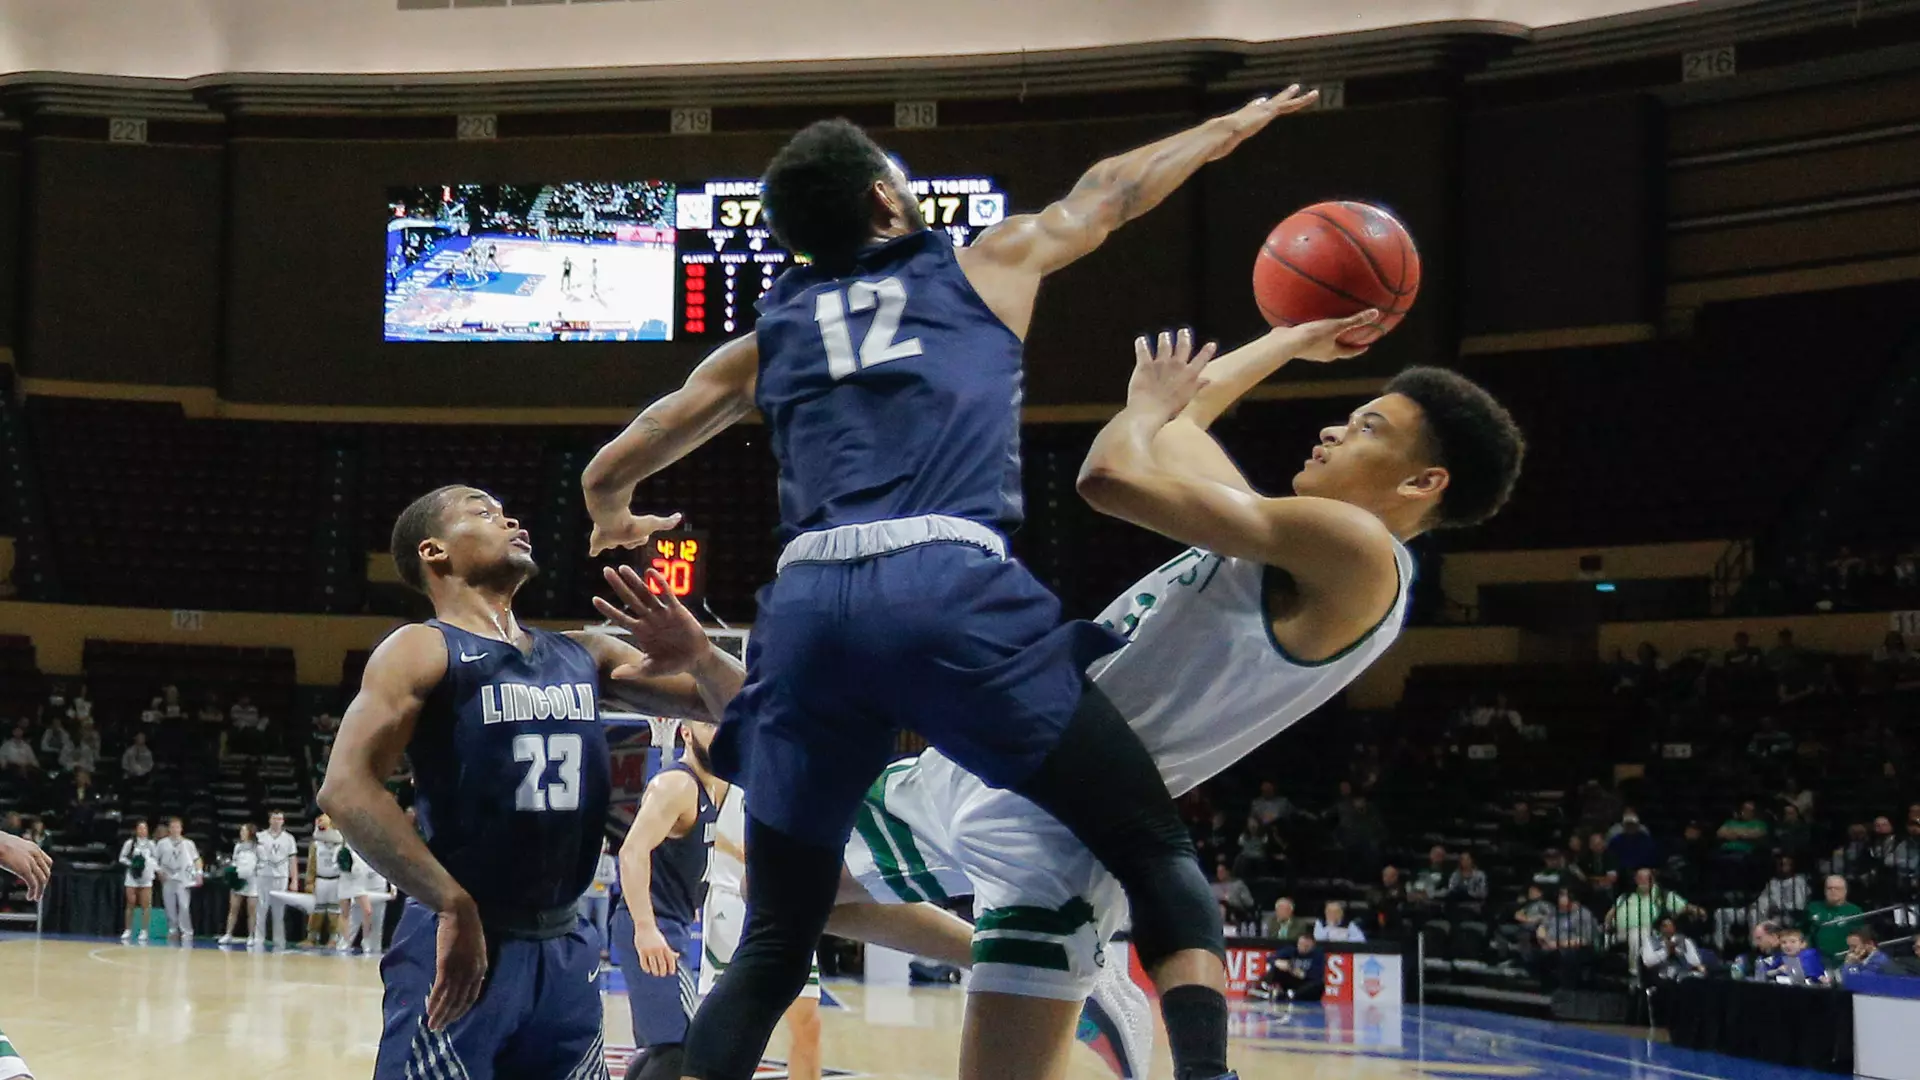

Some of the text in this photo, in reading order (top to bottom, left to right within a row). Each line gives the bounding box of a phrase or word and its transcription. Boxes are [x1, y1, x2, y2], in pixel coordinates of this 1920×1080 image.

[1686, 51, 1732, 78] 216
[674, 111, 708, 131] 219
[896, 105, 934, 126] 218
[113, 121, 145, 141] 221
[458, 117, 494, 138] 220
[931, 180, 990, 194] TIGERS
[720, 199, 762, 227] 37
[919, 197, 961, 224] 17
[682, 254, 715, 264] PLAYER
[814, 276, 923, 380] 12
[657, 539, 698, 562] 4:12
[481, 683, 595, 724] LINCOLN
[512, 733, 582, 811] 23
